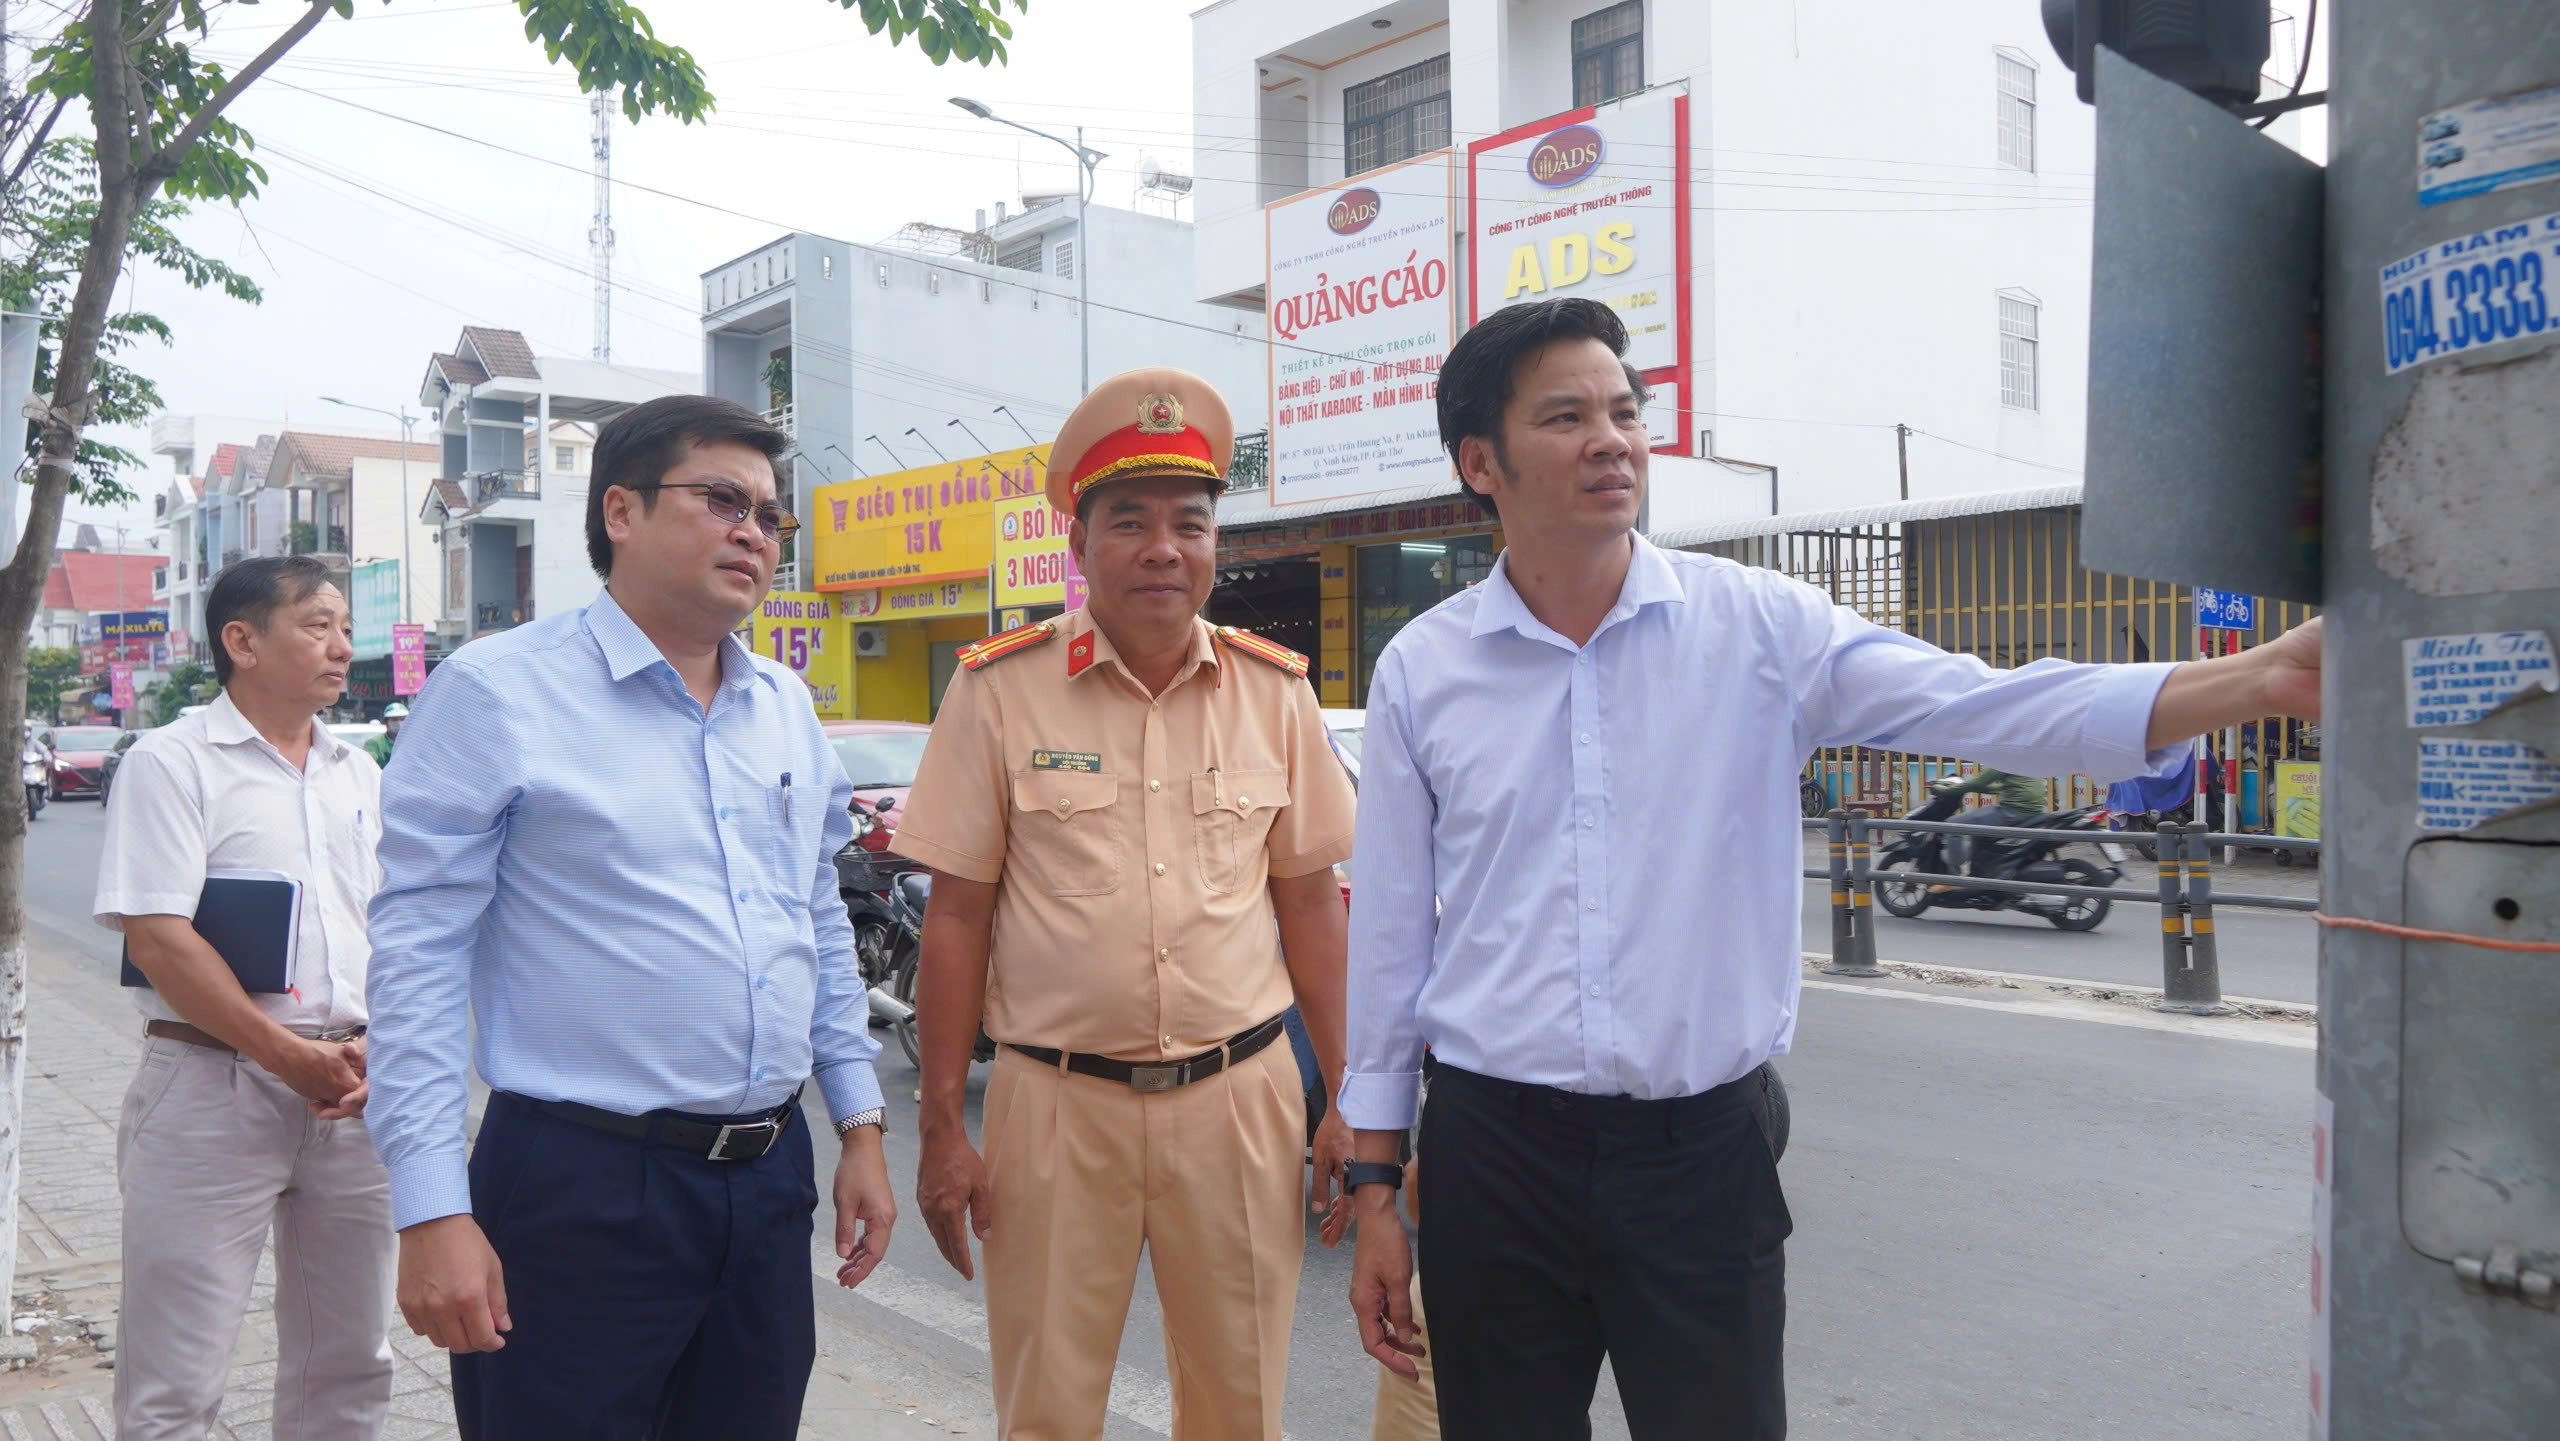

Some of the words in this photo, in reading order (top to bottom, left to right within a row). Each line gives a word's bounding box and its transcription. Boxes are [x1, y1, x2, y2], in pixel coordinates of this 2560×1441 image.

[1557, 143, 1598, 172] ADS
[1348, 201, 1377, 225] ADS
[1489, 221, 1512, 236] CÔNG
[1515, 218, 1526, 230] TY
[1528, 211, 1552, 226] CÔNG
[1553, 203, 1579, 220] NGHỆ
[1620, 185, 1652, 201] THÔNG
[1274, 257, 1292, 271] CÔNG
[1293, 256, 1303, 266] TY
[1325, 245, 1345, 257] CÔNG
[1400, 221, 1428, 236] THÔNG
[1429, 217, 1445, 228] ADS
[1505, 222, 1635, 299] ADS
[1274, 272, 1378, 341] QUẢNG
[1381, 248, 1446, 308] CÁO
[1282, 358, 1308, 375] THIẾT
[1312, 354, 1324, 369] KẾ
[1357, 343, 1384, 360] CÔNG
[1387, 335, 1415, 353] TRỌN
[1418, 331, 1436, 346] GÓI
[1278, 380, 1300, 401] BẢNG
[1302, 373, 1321, 398] HIỆU
[1329, 368, 1347, 391] CHỮ
[1373, 360, 1393, 383] MẶT
[1425, 354, 1443, 373] ALU
[1279, 404, 1294, 429] NỘI
[1296, 400, 1318, 422] THẤT
[1321, 395, 1363, 418] KARAOKE
[1373, 385, 1396, 410] MÀN
[1399, 380, 1423, 404] HÌNH
[856, 486, 895, 521] SIÊU
[902, 483, 933, 516] THỊ
[1008, 558, 1017, 588] 3
[105, 623, 165, 634] MAXILITE
[807, 599, 830, 619] GIÁ
